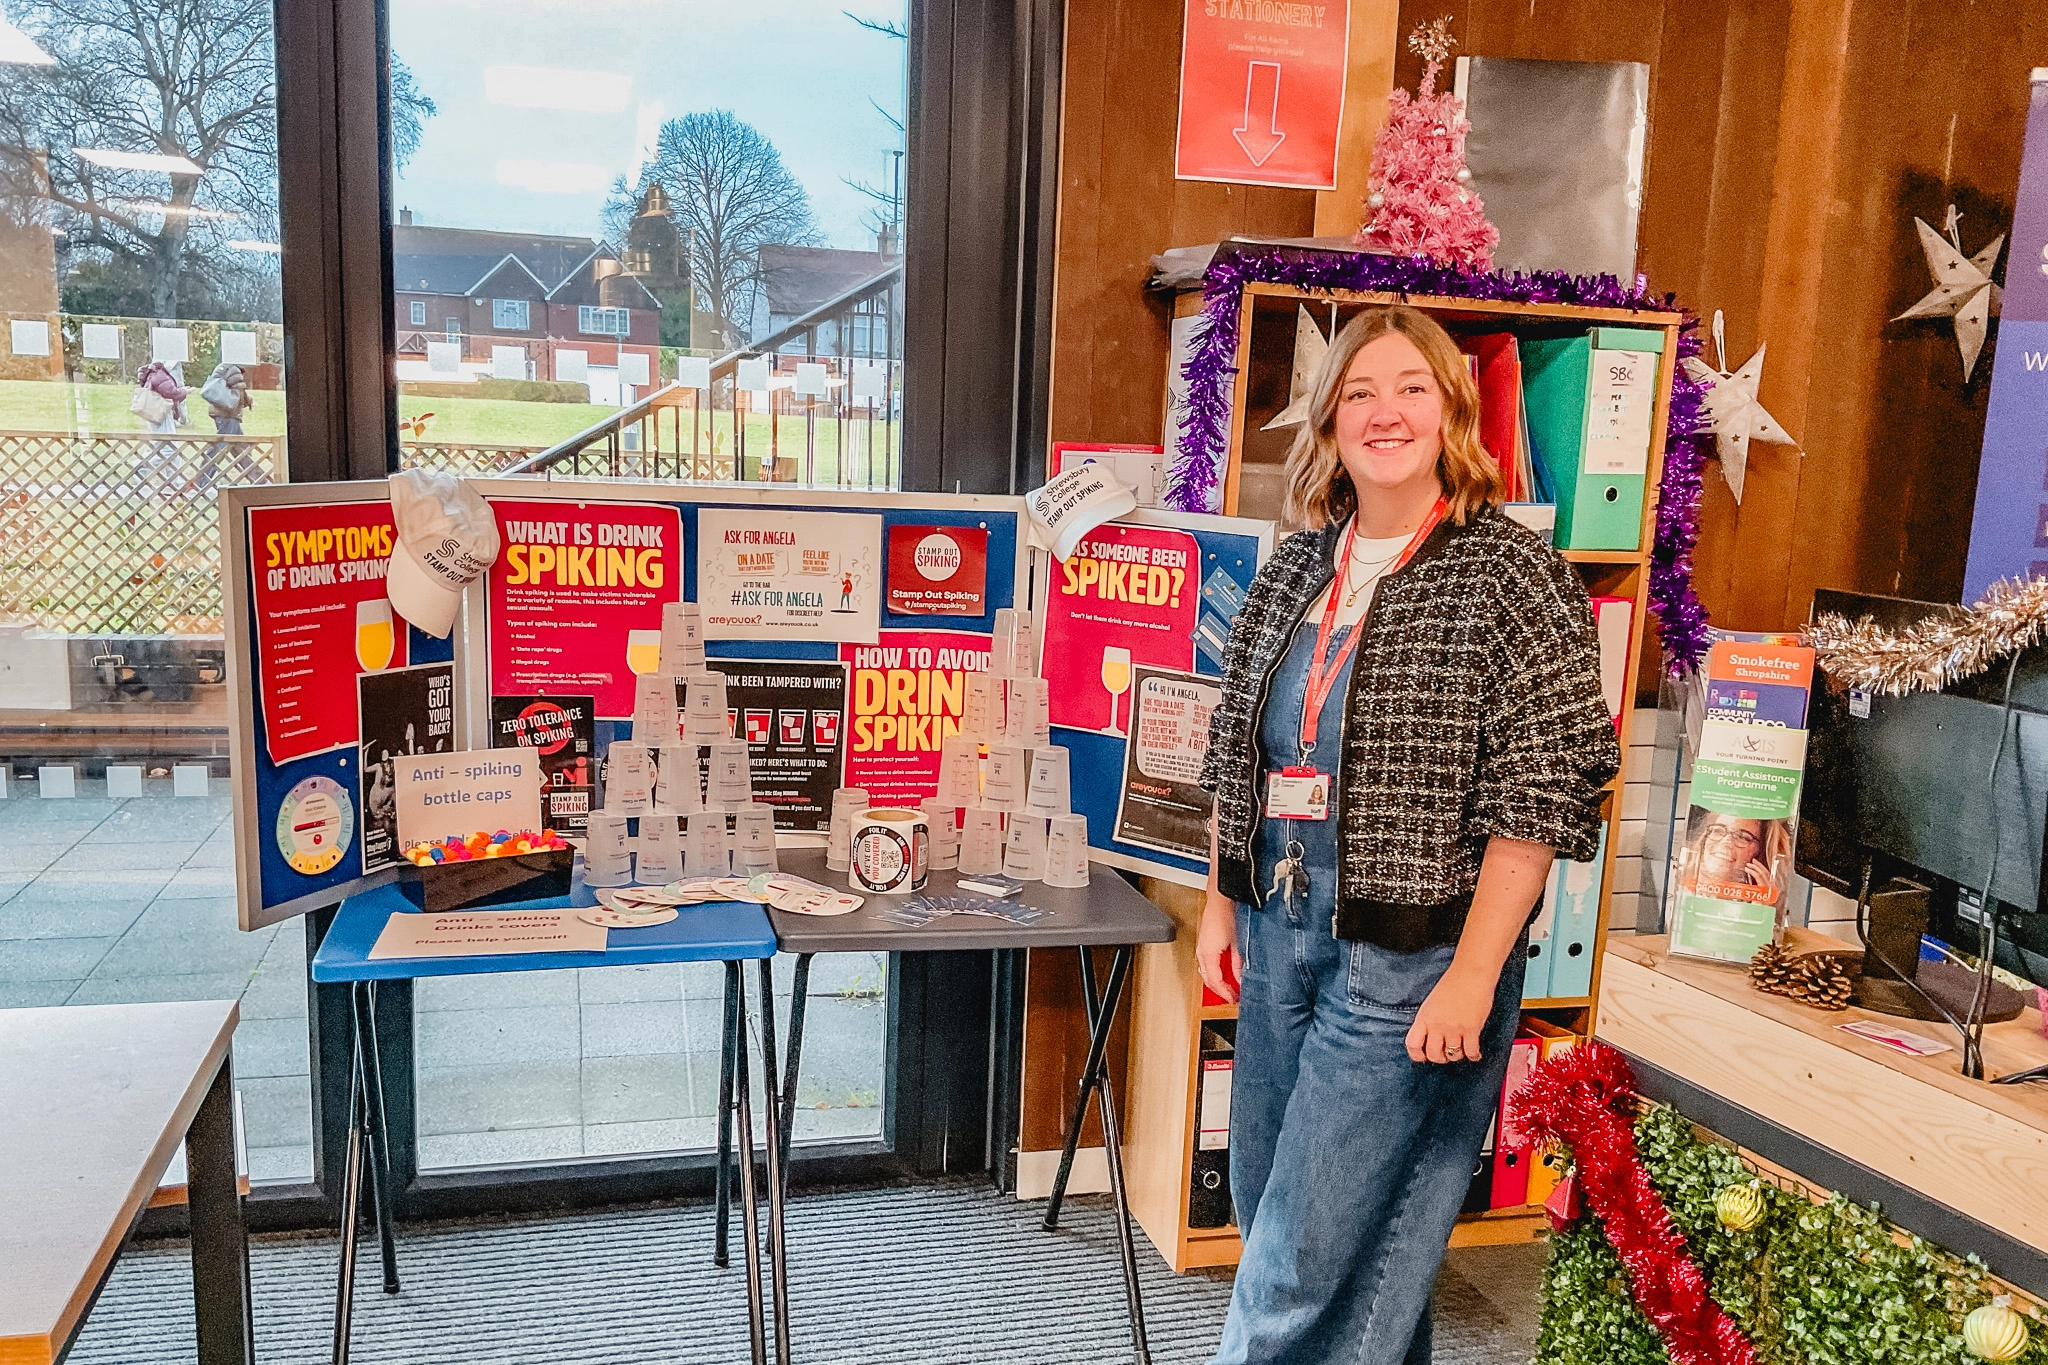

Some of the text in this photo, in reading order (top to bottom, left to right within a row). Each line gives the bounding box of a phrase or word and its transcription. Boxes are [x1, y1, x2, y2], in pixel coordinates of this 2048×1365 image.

[1206, 0, 1326, 28] STATIONERY
[1046, 466, 1090, 497] Shrewsbury
[1051, 479, 1080, 503] College
[1047, 480, 1104, 528] STAMP OUT SPIKING
[506, 521, 663, 547] WHAT IS DRINK
[724, 530, 796, 545] ASK FOR ANGELA
[266, 524, 392, 567] SYMPTOMS
[918, 547, 957, 556] STAMP OUT
[738, 552, 775, 565] ON A DATE
[803, 550, 830, 560] FEEL LIKE
[917, 555, 958, 568] SPIKING
[1072, 541, 1186, 568] AS SOMEONE BEEN
[424, 552, 449, 573] STAMP
[506, 544, 664, 588] SPIKING
[267, 568, 287, 591] OF
[289, 564, 336, 589] DRINK
[1061, 556, 1186, 609] SPIKED?
[731, 590, 823, 608] #ASK FOR ANGELA
[892, 589, 980, 602] Stamp Out Spiking
[535, 620, 558, 628] spiking
[708, 615, 762, 626] areyouok?
[1093, 614, 1107, 622] them
[1108, 616, 1122, 624] drink
[1123, 619, 1133, 628] any
[1149, 621, 1171, 631] alcohol
[855, 647, 903, 669] HOW
[907, 647, 932, 669] TO
[1729, 654, 1800, 671] Smokefree
[429, 674, 450, 688] WHO'S
[1735, 668, 1791, 681] Shropshire
[742, 676, 842, 689] BEEN TAMPERED WITH?
[429, 687, 450, 708] GOT
[855, 669, 969, 716] DRIN
[1144, 698, 1185, 710] ARE YOU DATE
[429, 708, 450, 723] YOUR
[500, 707, 583, 733] ZERO TOLERANCE
[1707, 707, 1756, 718] COMMUNITY
[429, 721, 450, 736] BACK?
[853, 715, 964, 752] SPIKIN
[1191, 730, 1203, 740] DOES
[517, 727, 574, 747] ON SPIKING
[1193, 739, 1204, 752] BIT
[749, 758, 766, 767] IKED?
[767, 759, 789, 767] HERE'S
[790, 759, 807, 767] WHAT
[817, 760, 828, 768] DO:
[1736, 754, 1766, 762] TURNING
[1767, 757, 1789, 765] POINT
[412, 762, 522, 782] Anti spiking
[1742, 770, 1796, 785] Assistance
[1130, 781, 1172, 797] areyouok?
[1717, 776, 1777, 792] Programme
[423, 789, 512, 806] bottle caps
[551, 802, 588, 812] SPIKING
[868, 827, 881, 835] FOIL
[872, 836, 880, 867] COVERED
[1723, 888, 1742, 898] 028
[1745, 890, 1769, 902] 3766
[435, 923, 493, 931] Drinks
[502, 934, 569, 942] yourself!
